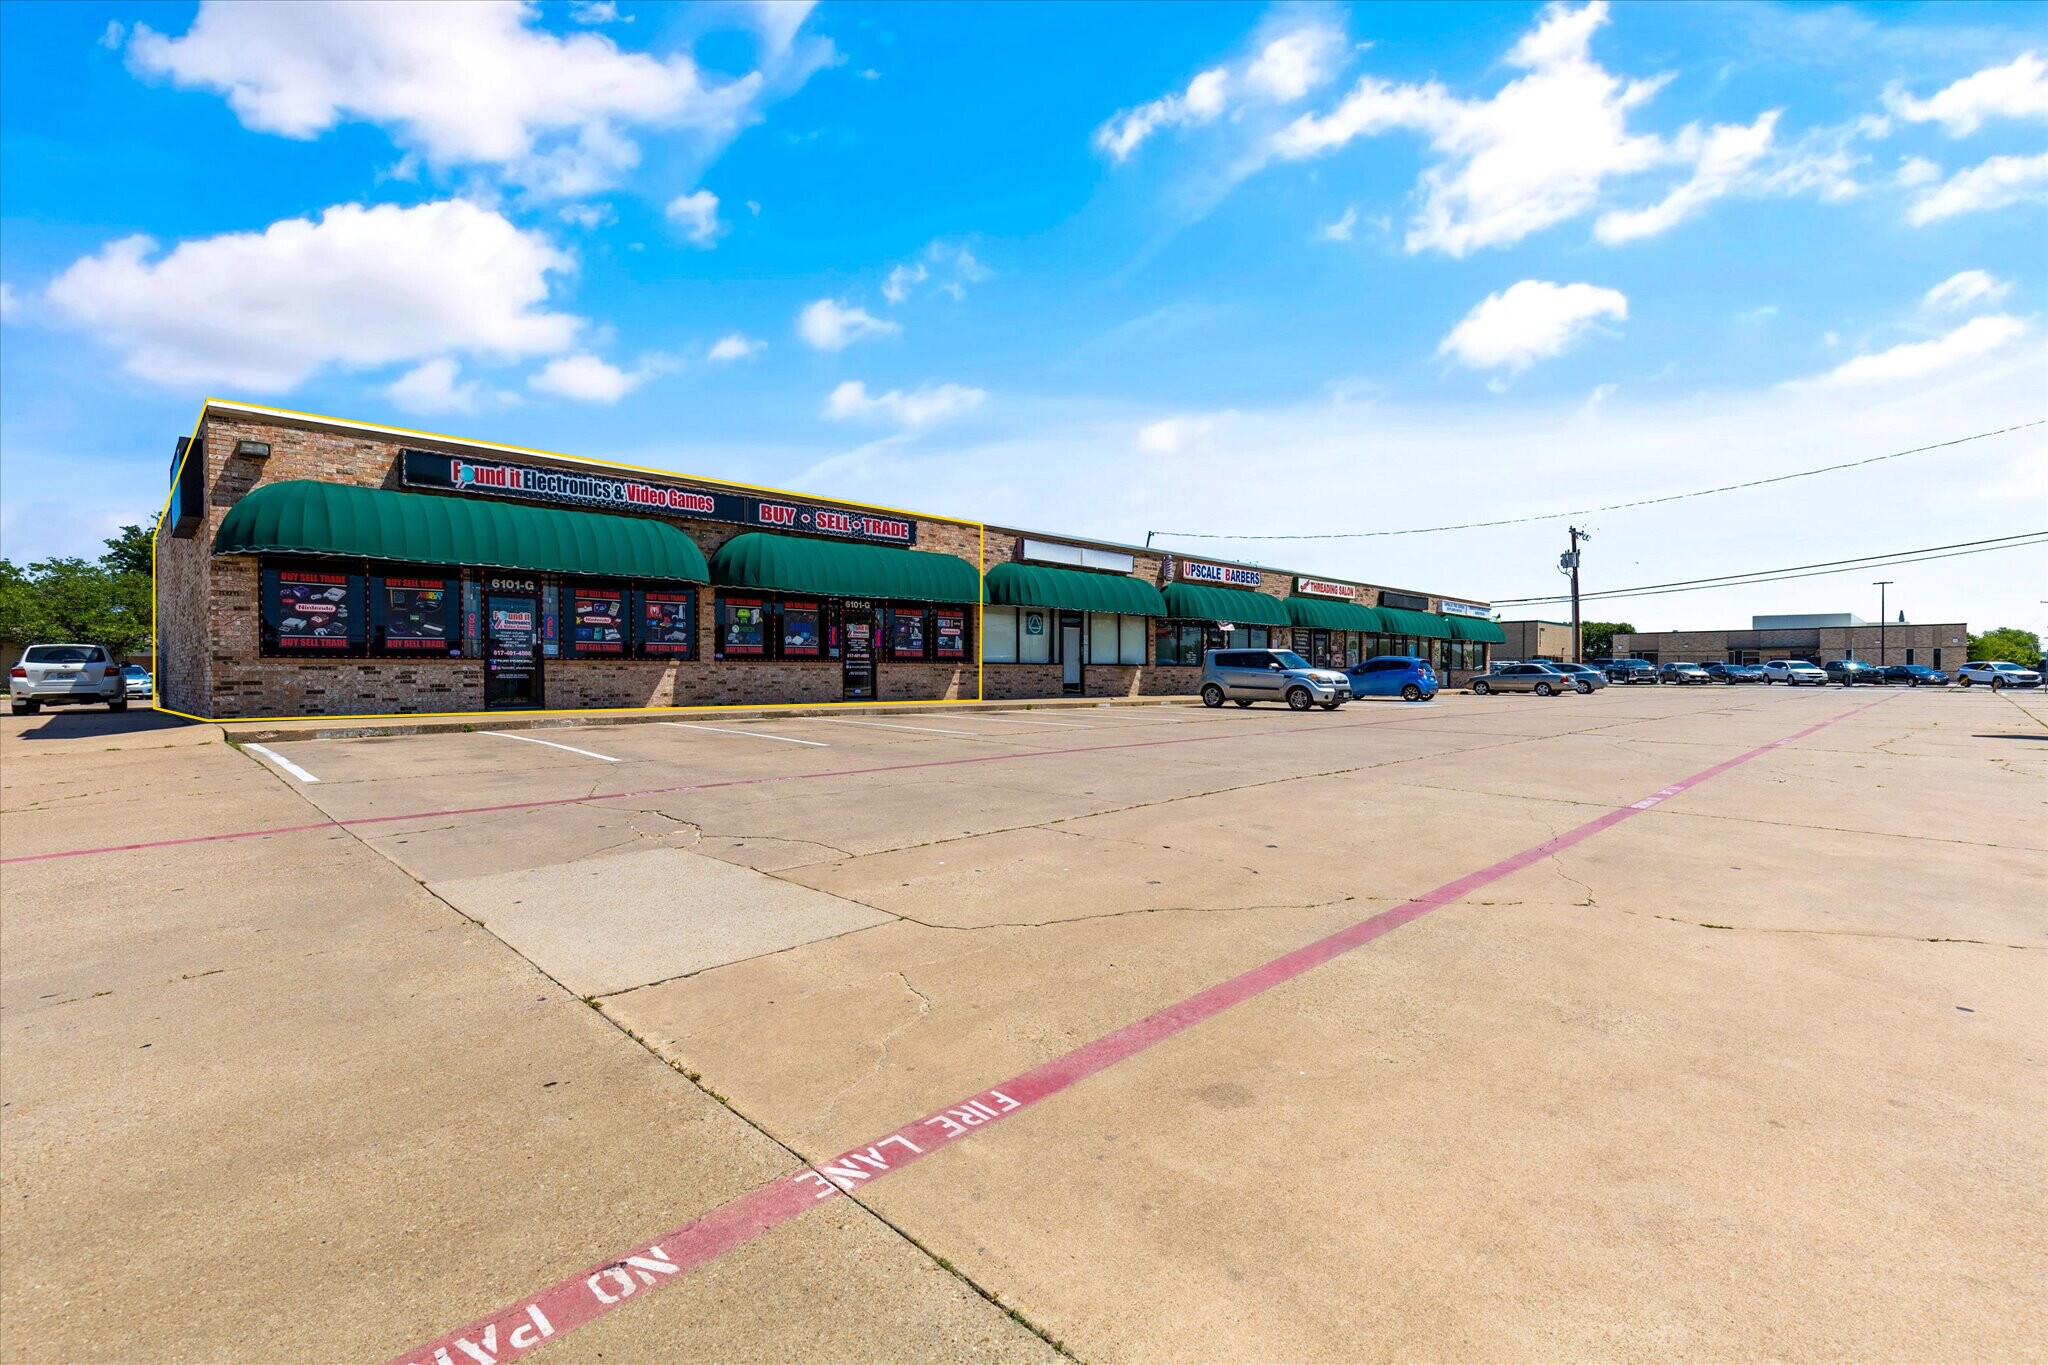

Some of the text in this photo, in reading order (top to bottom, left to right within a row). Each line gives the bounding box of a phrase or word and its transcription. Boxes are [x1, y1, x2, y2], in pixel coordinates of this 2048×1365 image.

[509, 467, 522, 488] it
[522, 469, 611, 499] Electronics
[613, 484, 625, 500] &
[626, 483, 666, 506] Video
[668, 489, 714, 512] Games
[760, 504, 909, 538] BUY SELL TRADE
[281, 572, 298, 580] BUY
[321, 575, 346, 584] TRADE
[1184, 562, 1260, 585] UPSCALE BARBERS
[386, 578, 444, 588] BUY SELL TRADE
[491, 579, 535, 590] 6101-G
[576, 589, 620, 599] BUY SELL TRADE
[1310, 581, 1338, 595] THREADING
[1338, 585, 1355, 597] SALON
[297, 604, 335, 612] Nintendo
[845, 601, 871, 609] 6101-G
[281, 638, 347, 647] BUY SELL TRADE
[404, 640, 421, 648] SELL
[422, 640, 446, 648] TRADE
[602, 644, 621, 652] TRADE
[794, 1091, 1021, 1199] FIRE LANE
[587, 1246, 680, 1304] NO
